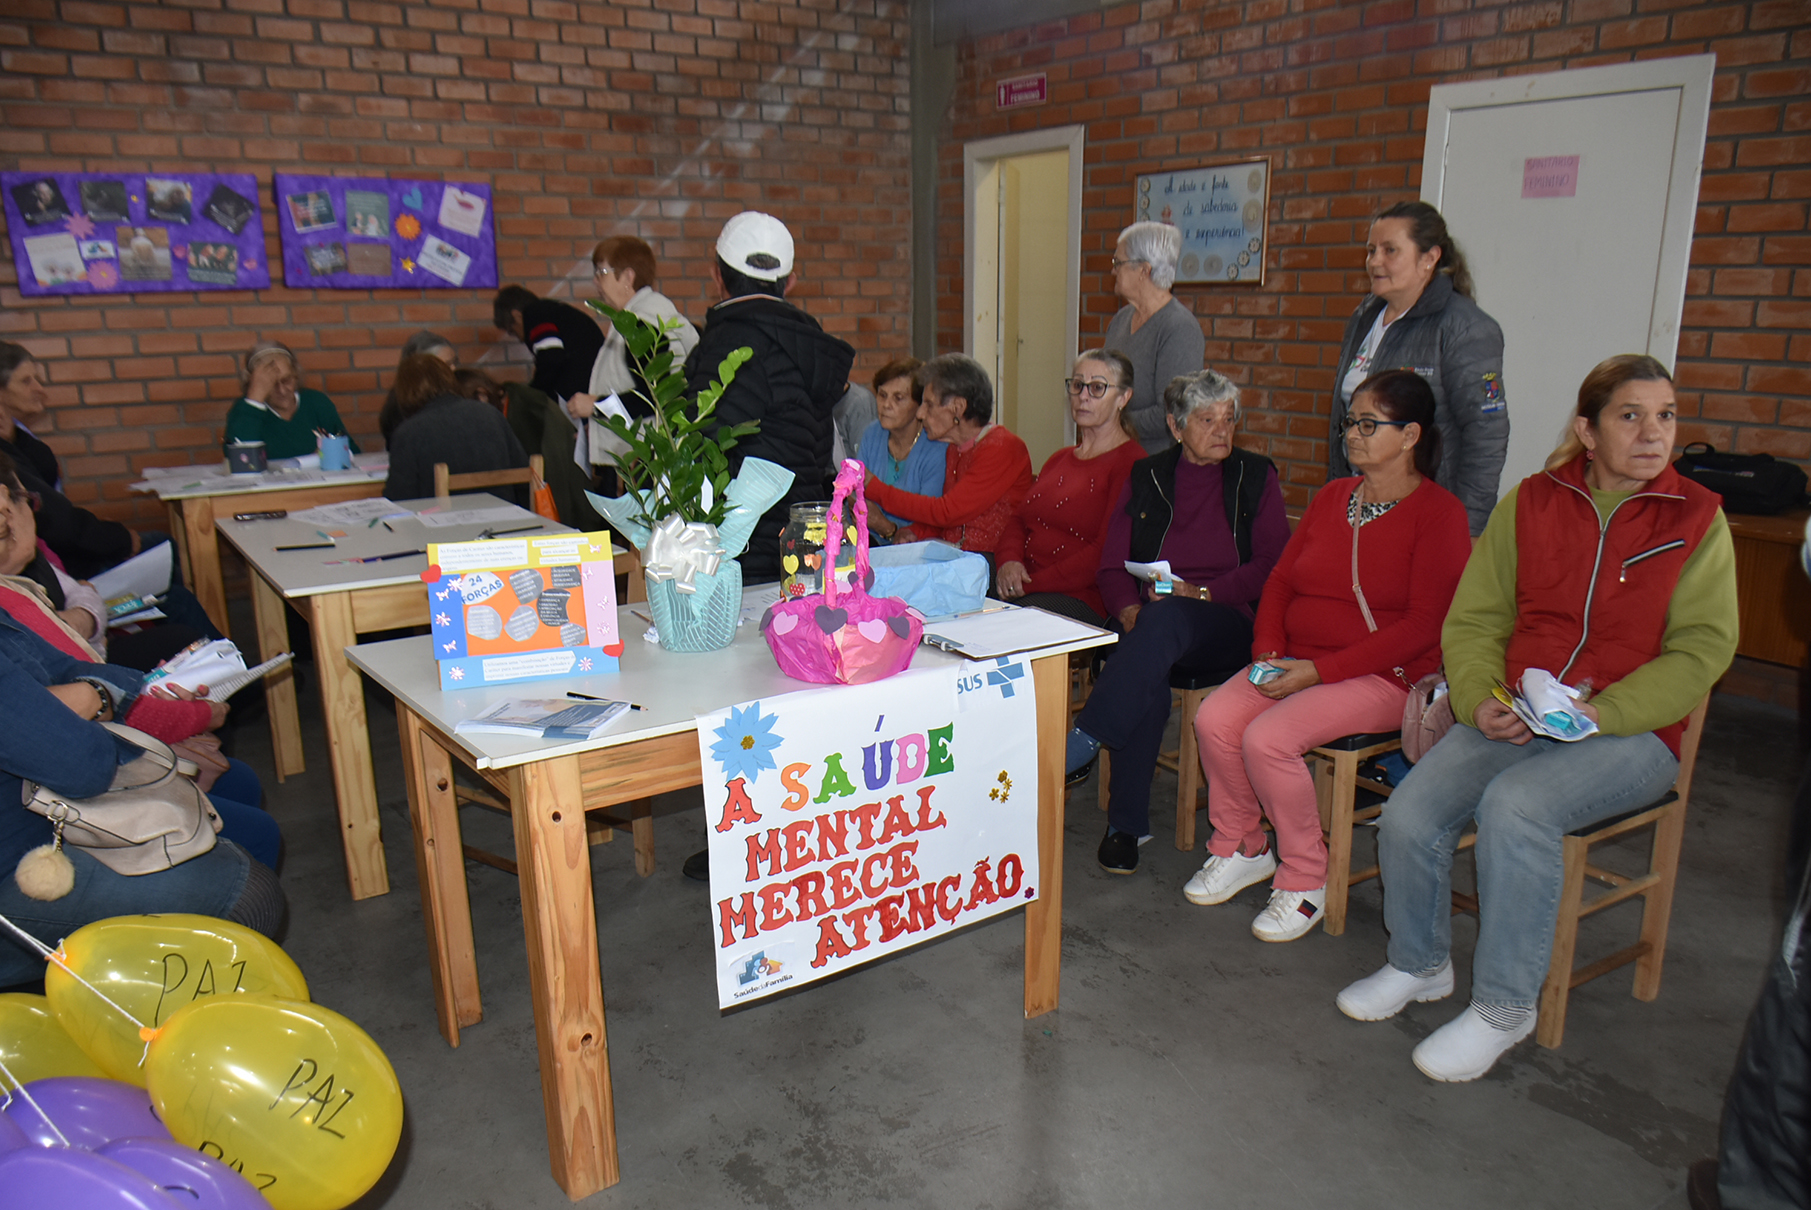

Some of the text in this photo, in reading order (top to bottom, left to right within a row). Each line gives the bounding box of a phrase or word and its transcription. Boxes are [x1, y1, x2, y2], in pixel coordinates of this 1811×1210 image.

[461, 579, 503, 605] FORÇAS
[468, 574, 483, 587] 24
[957, 673, 983, 695] SUS
[714, 714, 955, 833] A SAÚDE
[744, 785, 947, 883] MENTAL
[717, 839, 920, 948] MERECE
[154, 953, 248, 1028] PAZ
[268, 1058, 355, 1140] PAZ
